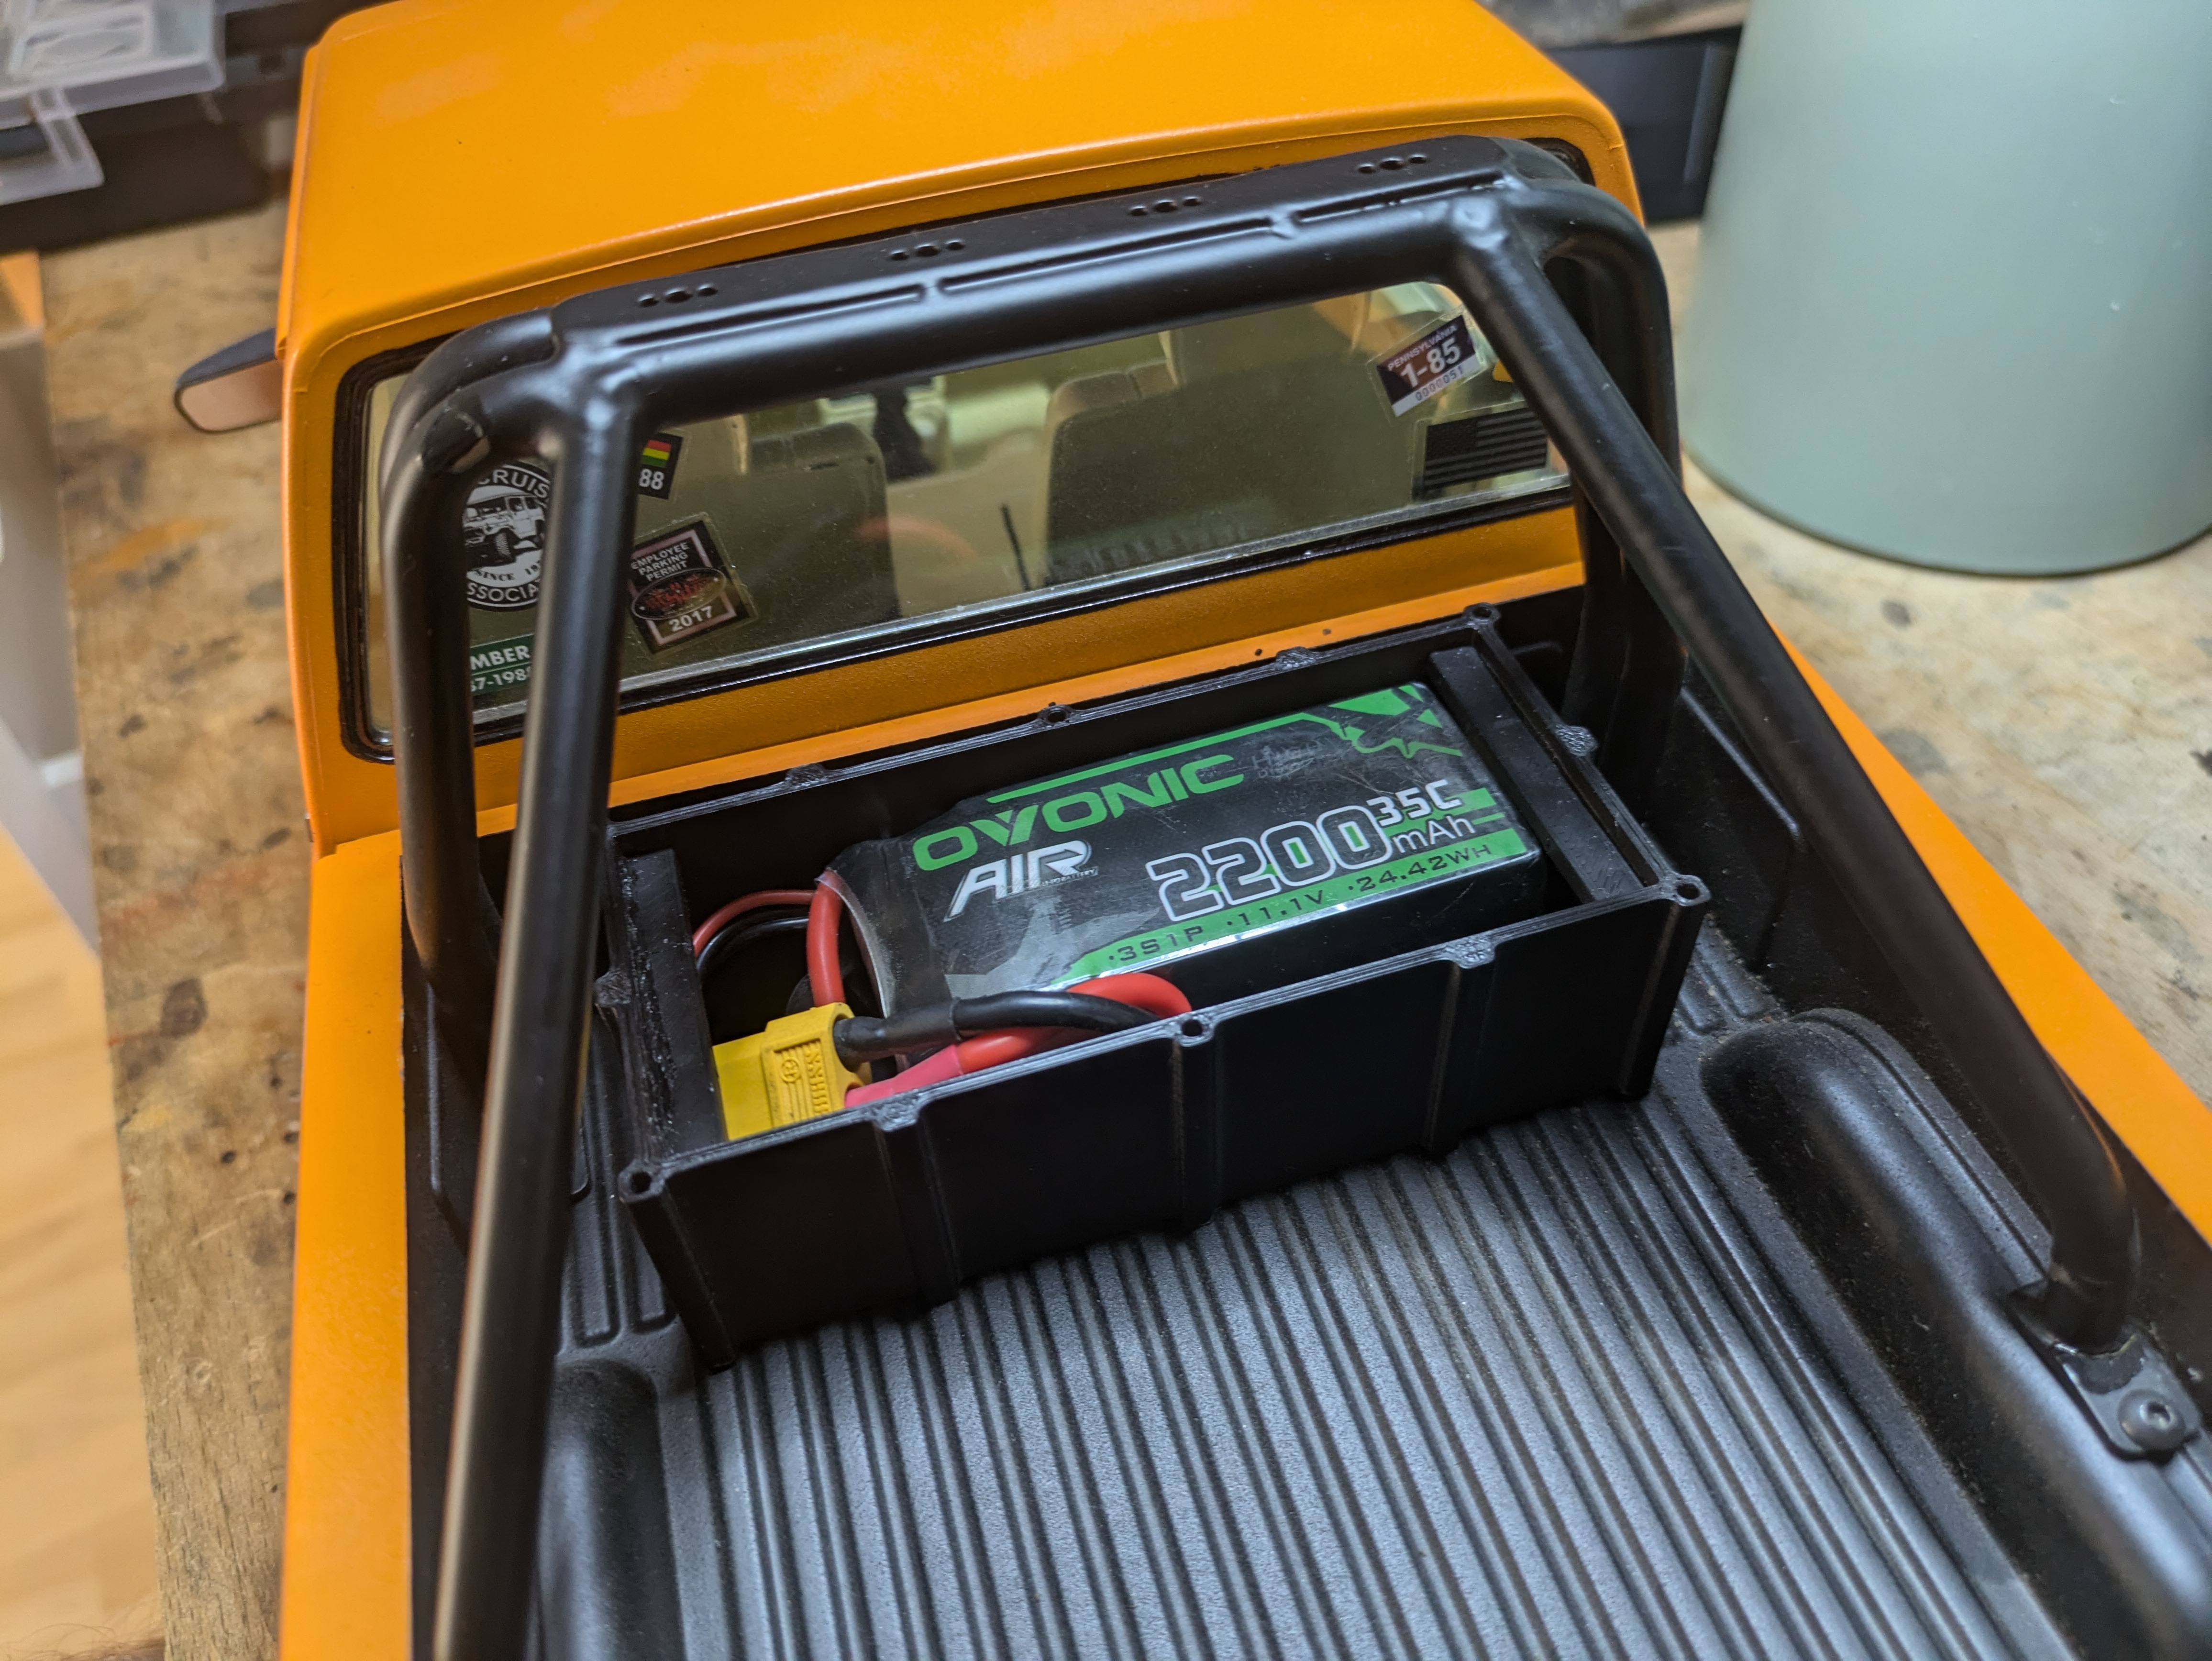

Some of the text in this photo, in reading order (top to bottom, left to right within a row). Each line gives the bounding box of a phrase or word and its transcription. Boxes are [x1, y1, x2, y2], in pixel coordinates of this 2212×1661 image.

[1387, 324, 1458, 371] PENNSYLVANIA
[1400, 337, 1461, 388] 1-85
[478, 469, 550, 498] RUIS
[639, 468, 665, 490] 88
[630, 542, 690, 569] EMPLOYEE
[639, 552, 688, 576] PARKING
[646, 560, 687, 582] PERMIT
[466, 580, 540, 602] SSOCIA
[669, 606, 713, 632] 2017
[470, 645, 531, 670] MBER
[470, 666, 531, 692] 7-198
[912, 754, 1244, 871] OVONIC
[1366, 779, 1462, 827] 35C
[1392, 815, 1476, 853] mAh
[1145, 805, 1393, 921] 2200
[943, 840, 1092, 922] AIR
[1117, 844, 1492, 961] 3S1P 11.1V 24.42WH
